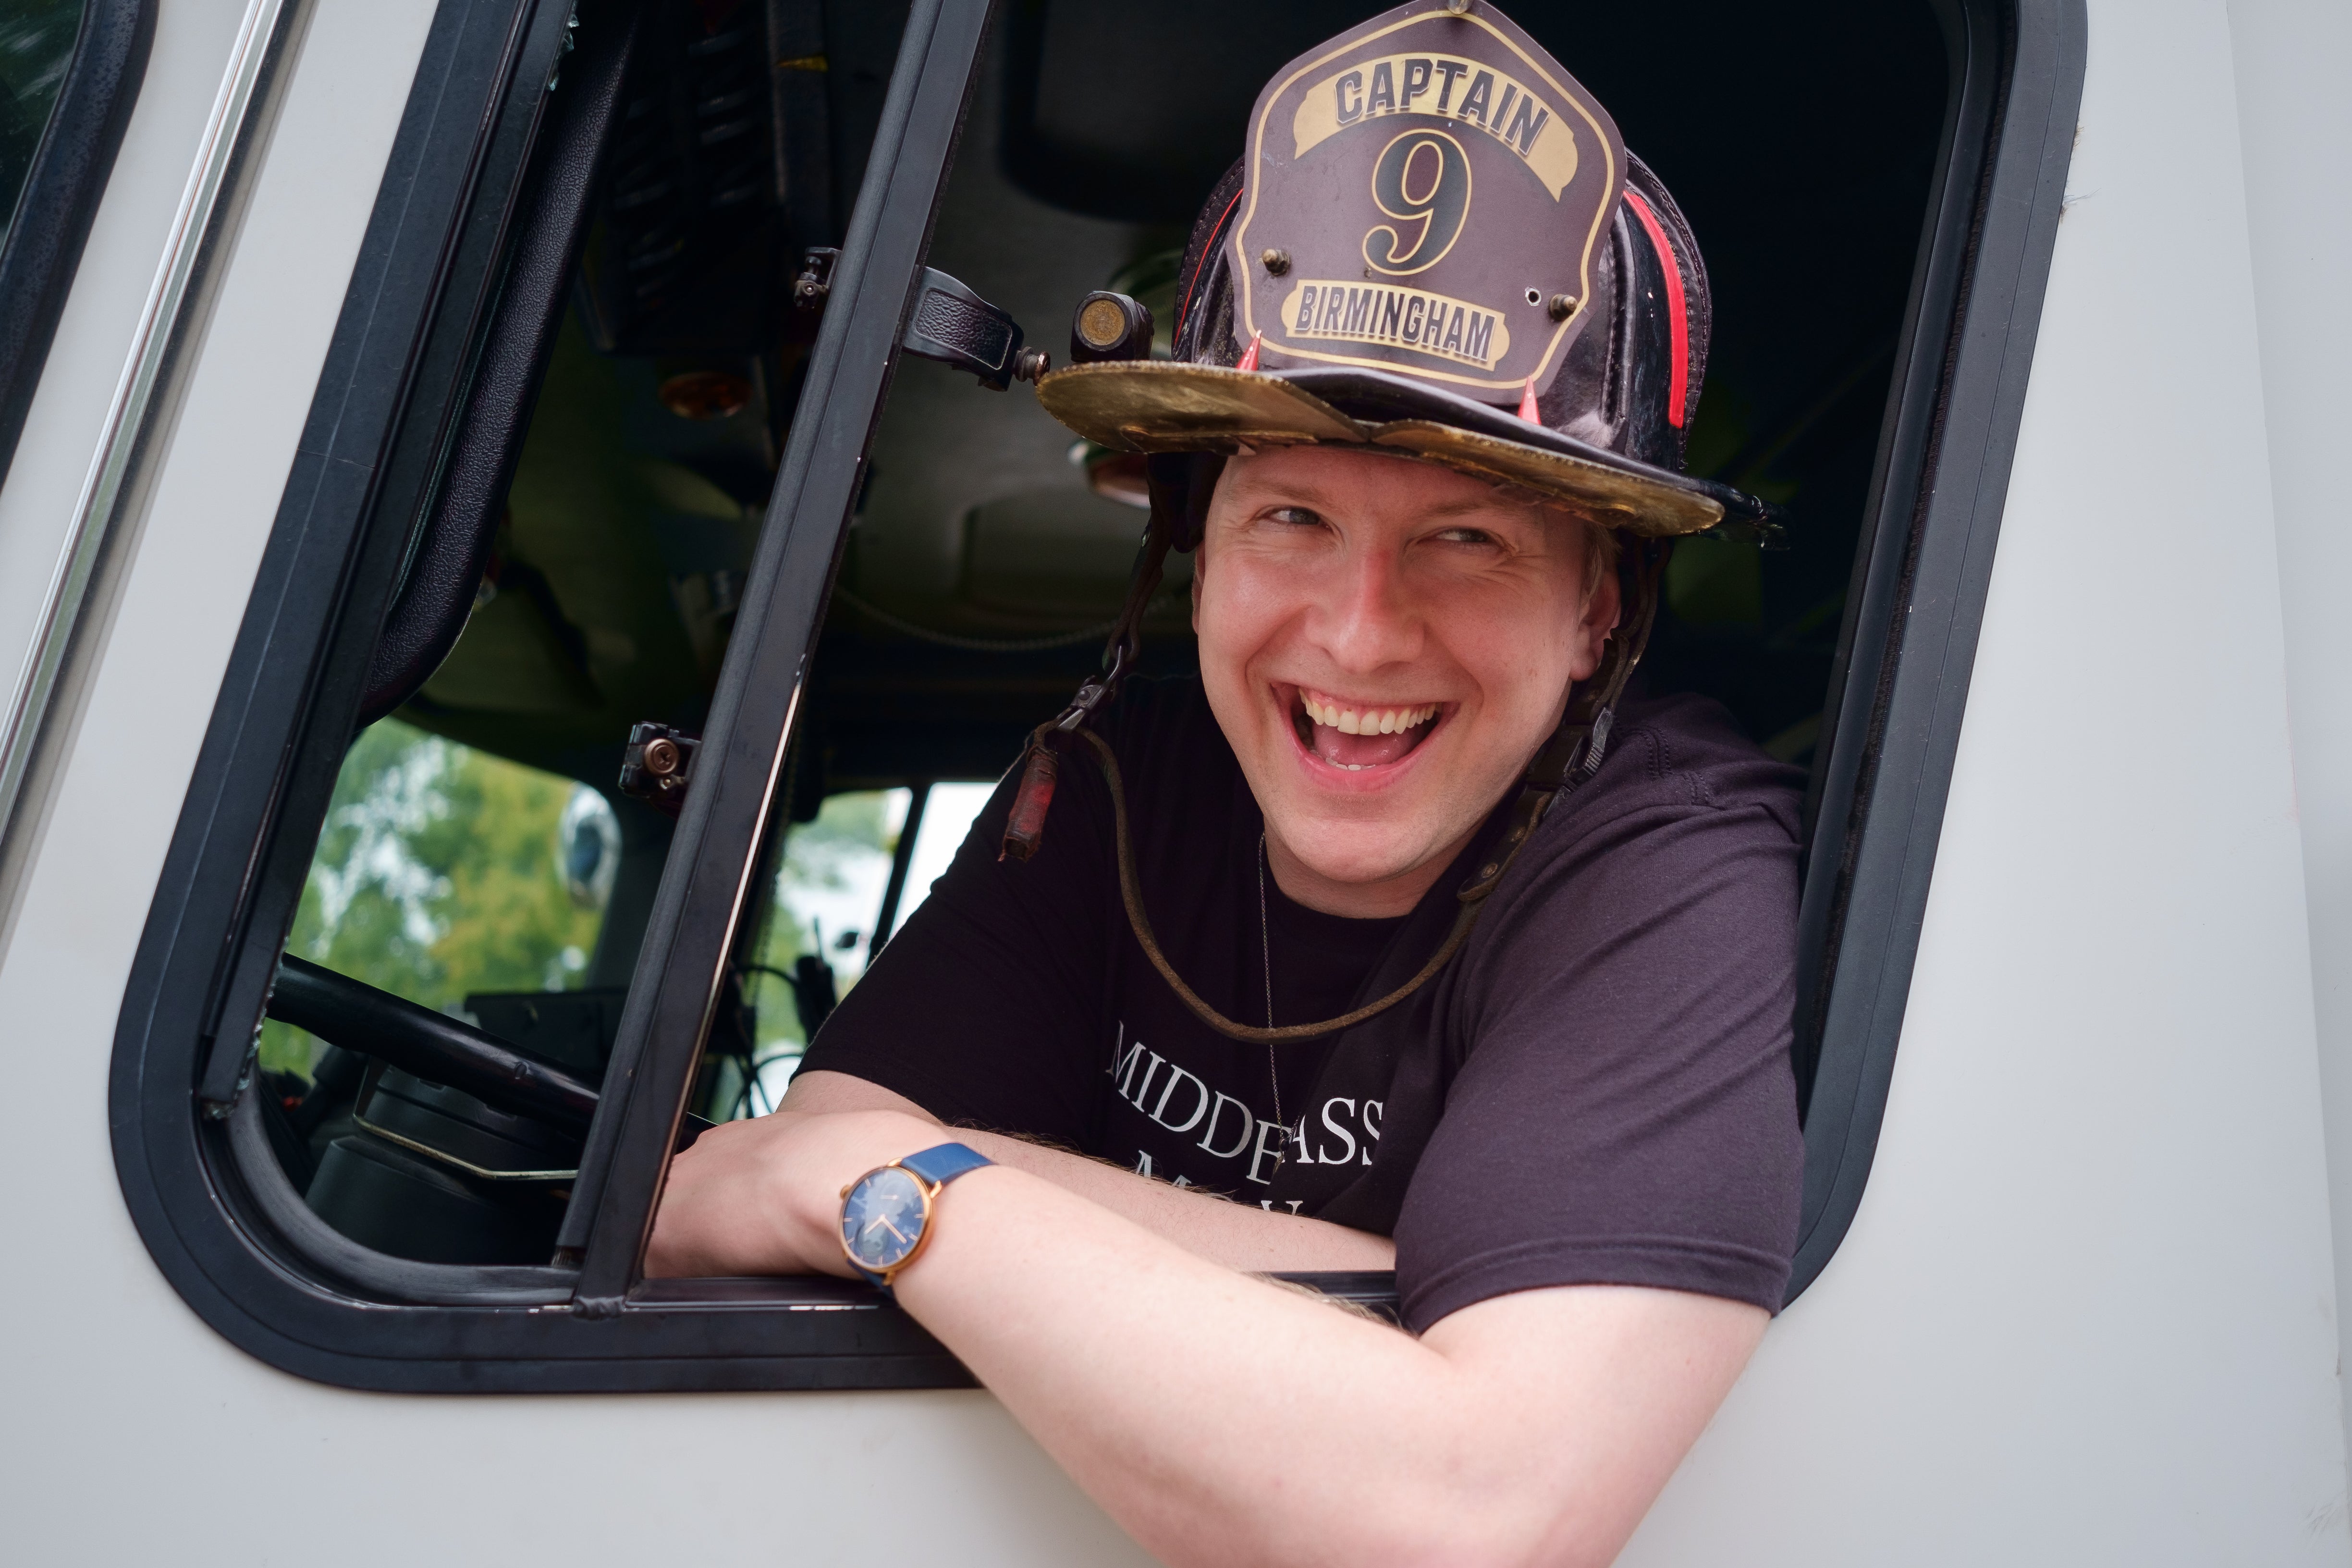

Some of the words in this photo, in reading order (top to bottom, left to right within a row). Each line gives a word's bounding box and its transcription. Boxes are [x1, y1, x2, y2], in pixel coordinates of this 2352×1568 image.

[1335, 58, 1549, 156] CAPTAIN
[1362, 128, 1472, 276] 9
[1294, 285, 1496, 363] BIRMINGHAM
